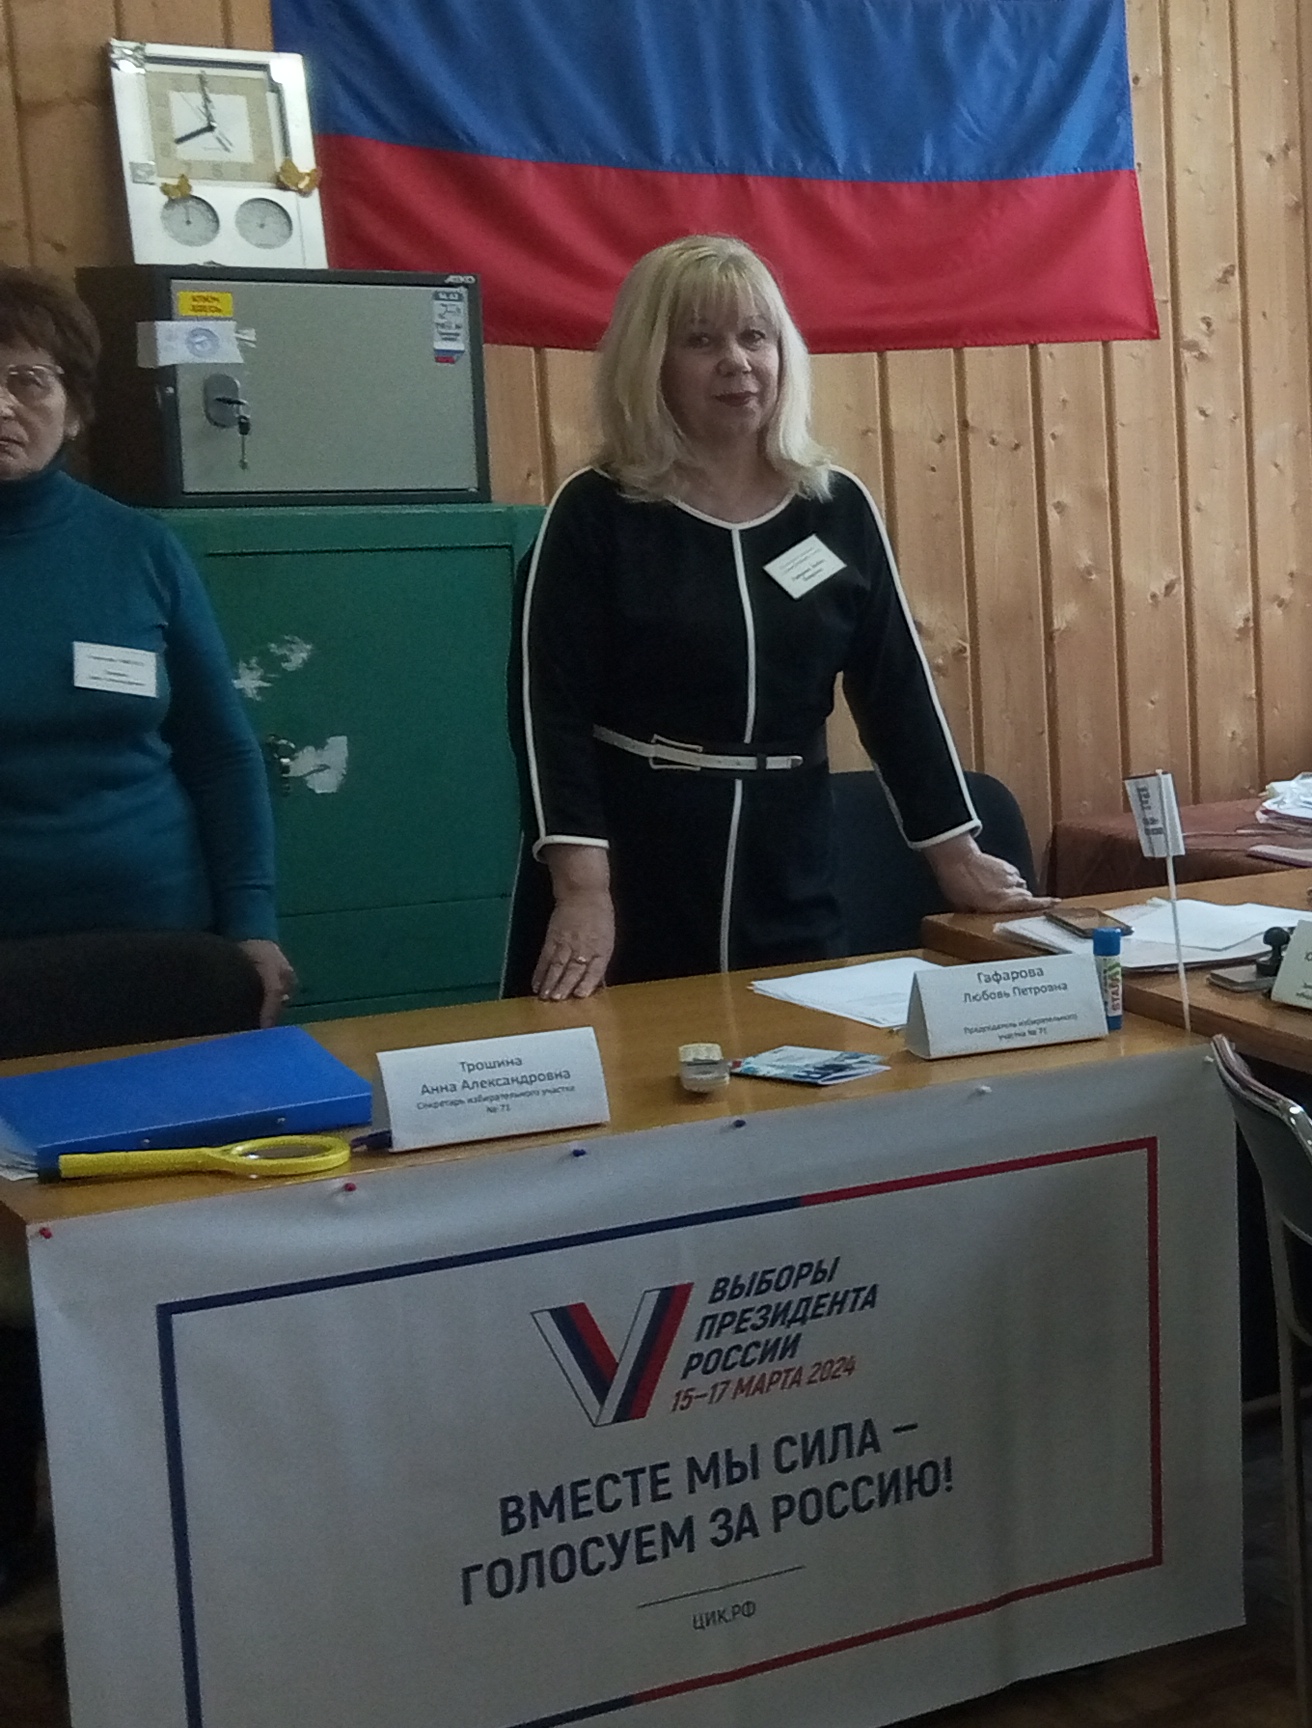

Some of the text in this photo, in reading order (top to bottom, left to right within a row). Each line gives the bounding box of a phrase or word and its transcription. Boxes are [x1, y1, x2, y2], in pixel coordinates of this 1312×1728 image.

[963, 981, 1068, 1003] Любовь Петровна
[977, 966, 1045, 984] Гафарова
[421, 1069, 571, 1095] Анна Александровна
[459, 1056, 523, 1073] Трошина
[708, 1256, 840, 1304] ВЫБОРЫ
[694, 1283, 879, 1342] ПРЕЗИДЕНТА
[681, 1332, 802, 1380] РОССИИ
[733, 1364, 803, 1398] МАРТА
[805, 1355, 856, 1386] 2024
[500, 1461, 673, 1536] ВМЕСТЕ
[686, 1443, 759, 1494] МЫ
[773, 1418, 881, 1474] СИЛА
[461, 1456, 954, 1606] ГОЛОСУЕМ ЗА РОССИЮ!
[692, 1600, 757, 1631] ЦИК.РФ
